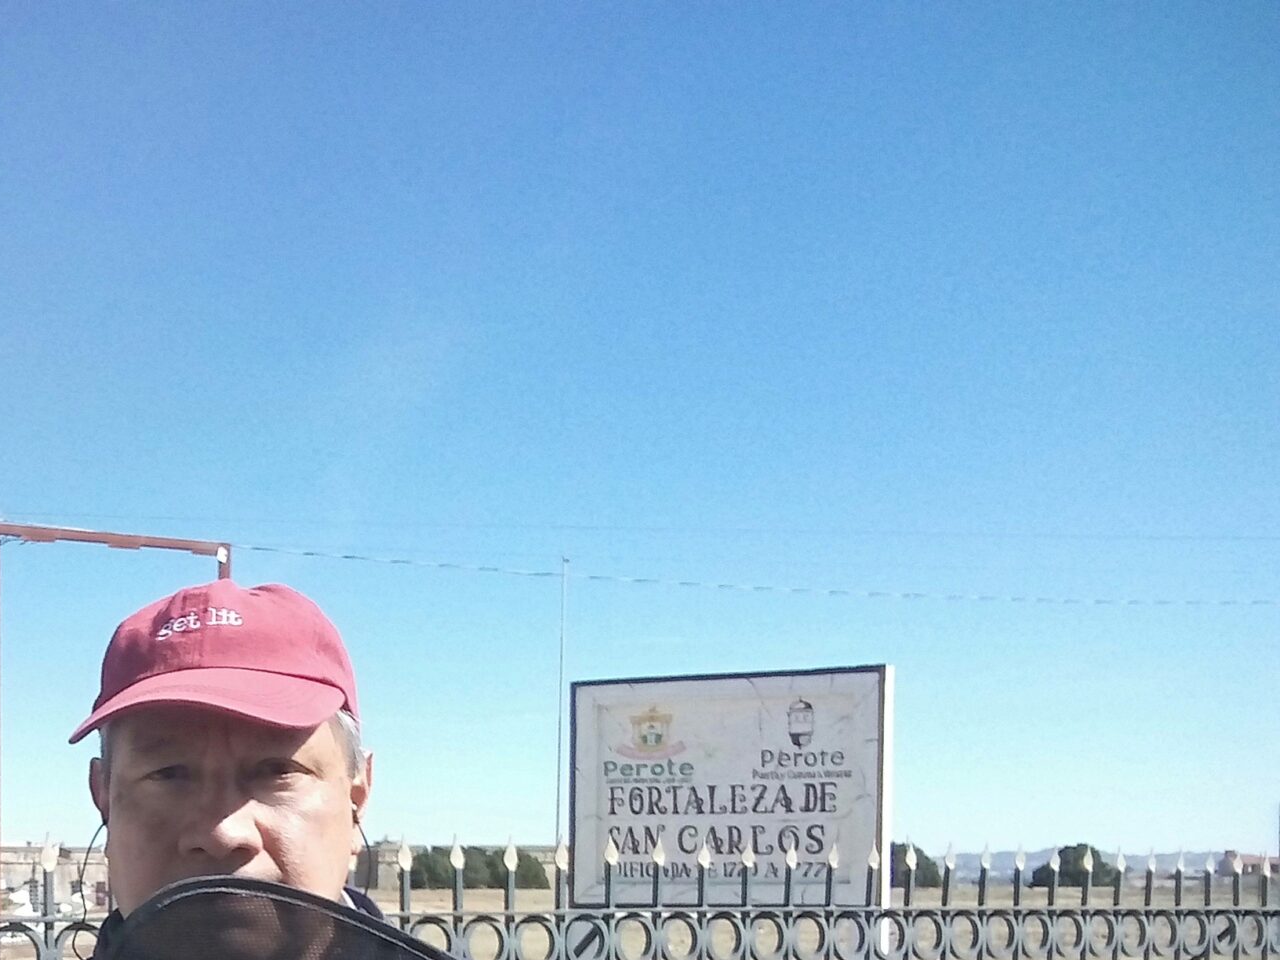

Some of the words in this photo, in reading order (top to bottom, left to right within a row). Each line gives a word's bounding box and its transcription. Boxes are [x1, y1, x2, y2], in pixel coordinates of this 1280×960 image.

[603, 758, 695, 777] Perote
[760, 748, 845, 768] Perote
[607, 783, 794, 816] FORTALEZA
[799, 781, 839, 813] DE
[606, 823, 666, 855] SAN
[677, 824, 826, 856] CARLOS
